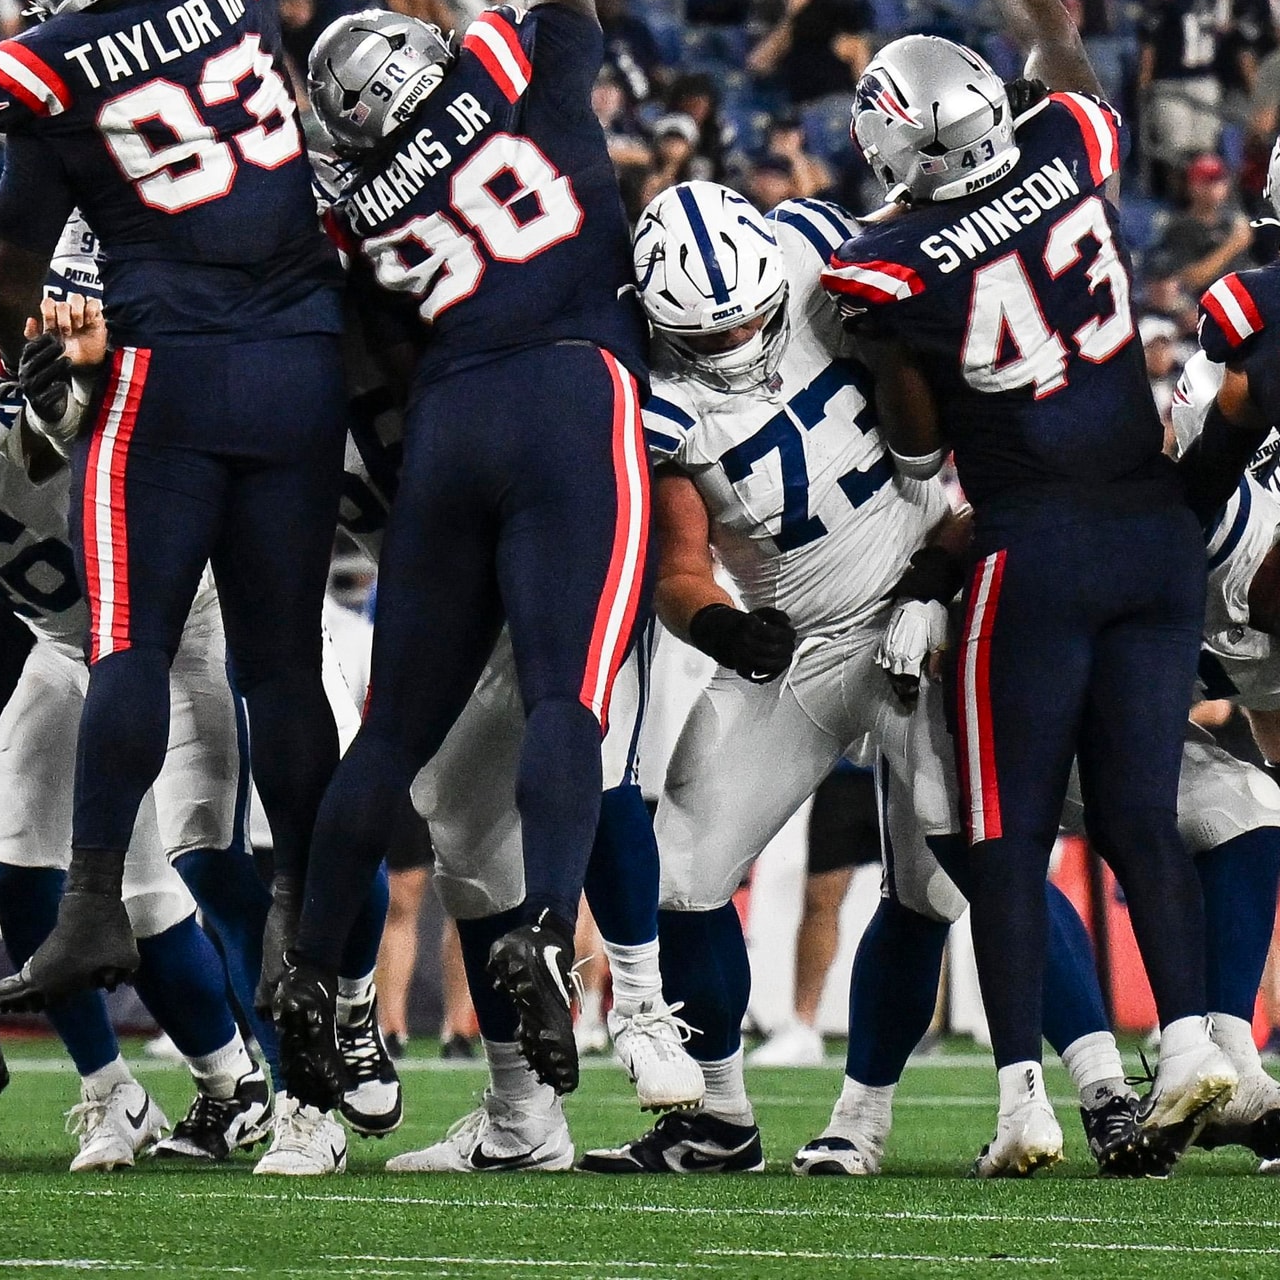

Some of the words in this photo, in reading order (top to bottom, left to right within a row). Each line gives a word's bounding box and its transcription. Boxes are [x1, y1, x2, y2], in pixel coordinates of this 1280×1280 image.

[96, 32, 303, 215] 93
[391, 74, 435, 123] PATRIOTS
[345, 127, 452, 236] PHARMS
[445, 91, 492, 146] JR
[961, 138, 995, 170] 43
[965, 158, 1012, 194] PATRIOTS
[920, 156, 1080, 274] SWINSON
[711, 304, 743, 322] COLTS
[960, 194, 1136, 401] 43
